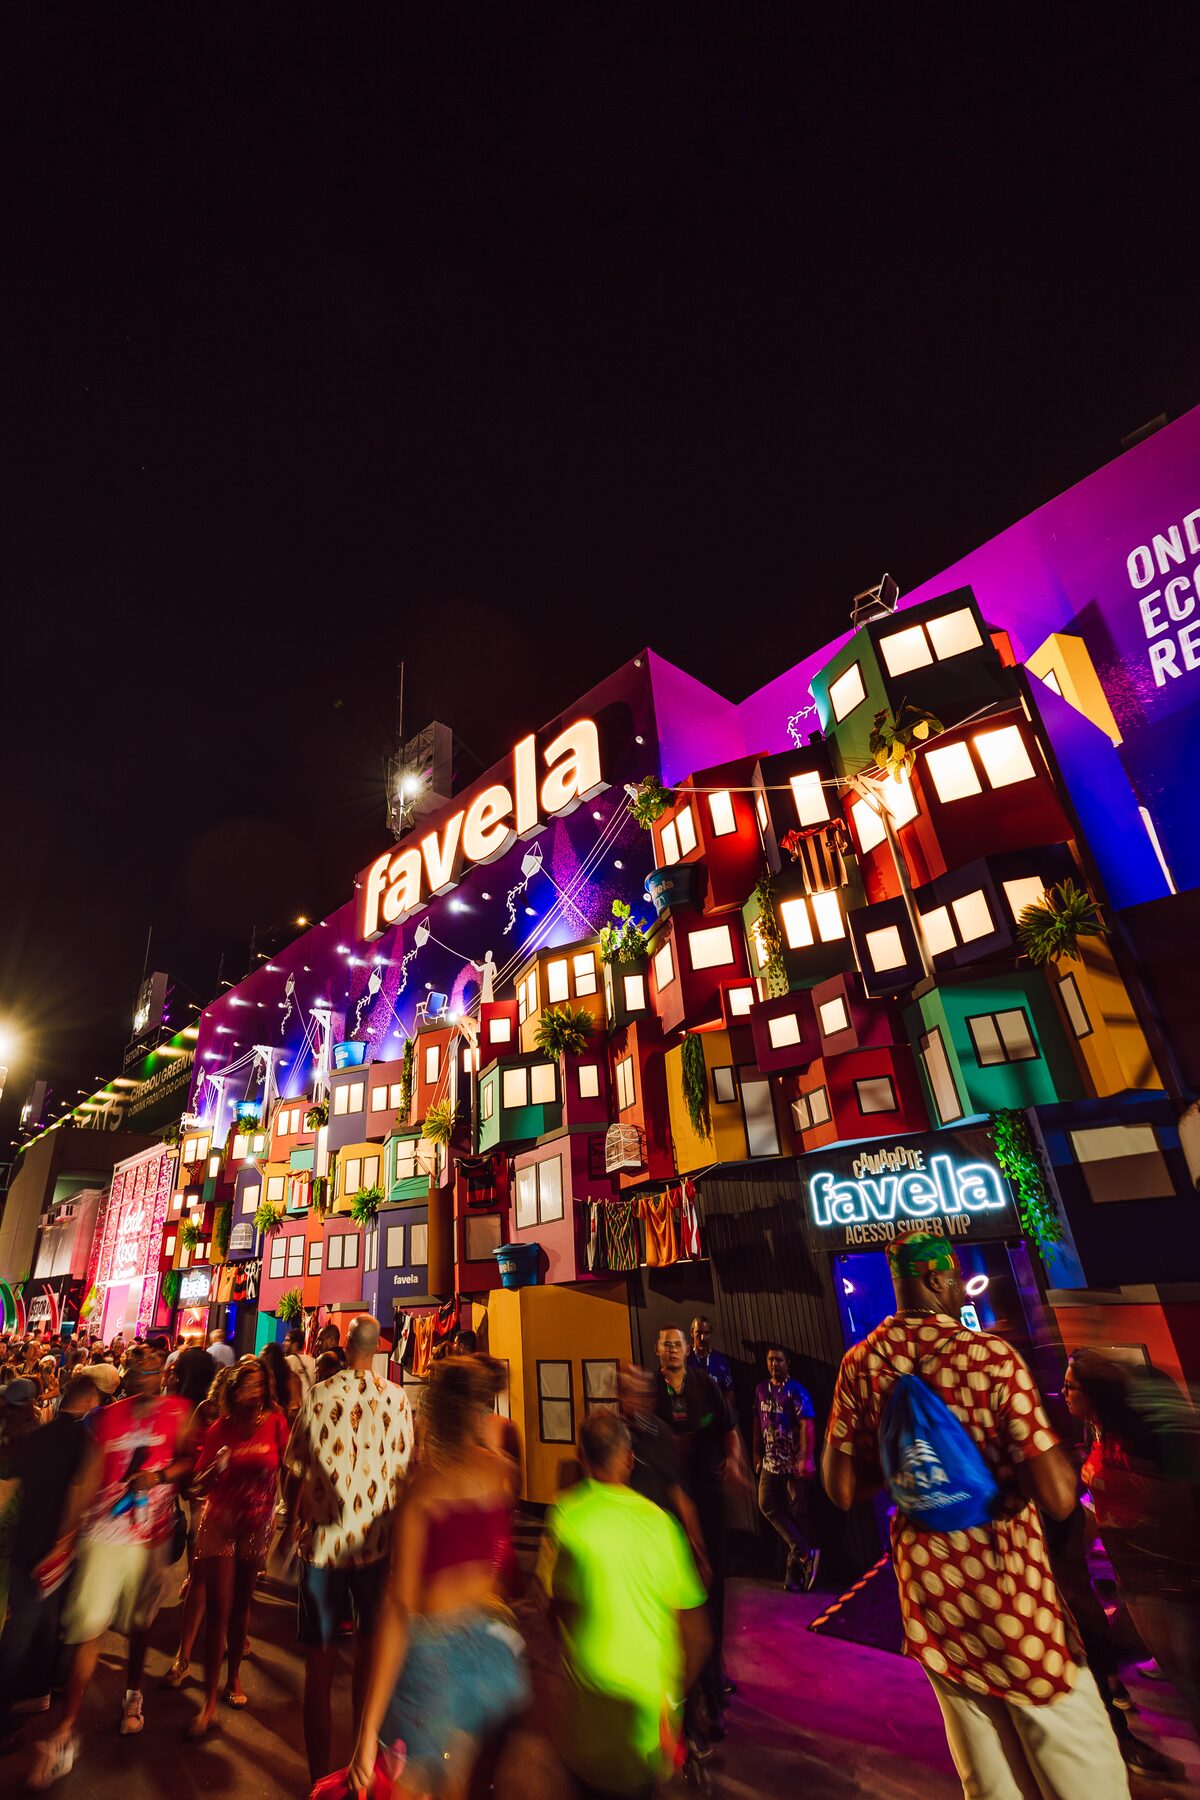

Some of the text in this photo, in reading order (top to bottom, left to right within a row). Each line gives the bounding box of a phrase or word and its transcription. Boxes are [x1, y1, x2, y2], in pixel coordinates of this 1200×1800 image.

[1139, 563, 1200, 639] EC
[363, 719, 606, 940] favela
[130, 1071, 161, 1102] CHEGOU
[161, 1052, 189, 1083] GREEN
[852, 1146, 926, 1179] CAMAROTE
[810, 1155, 1006, 1225] favela
[845, 1221, 896, 1245] ACESSO
[944, 1213, 971, 1236] VIP
[393, 1273, 419, 1285] favela
